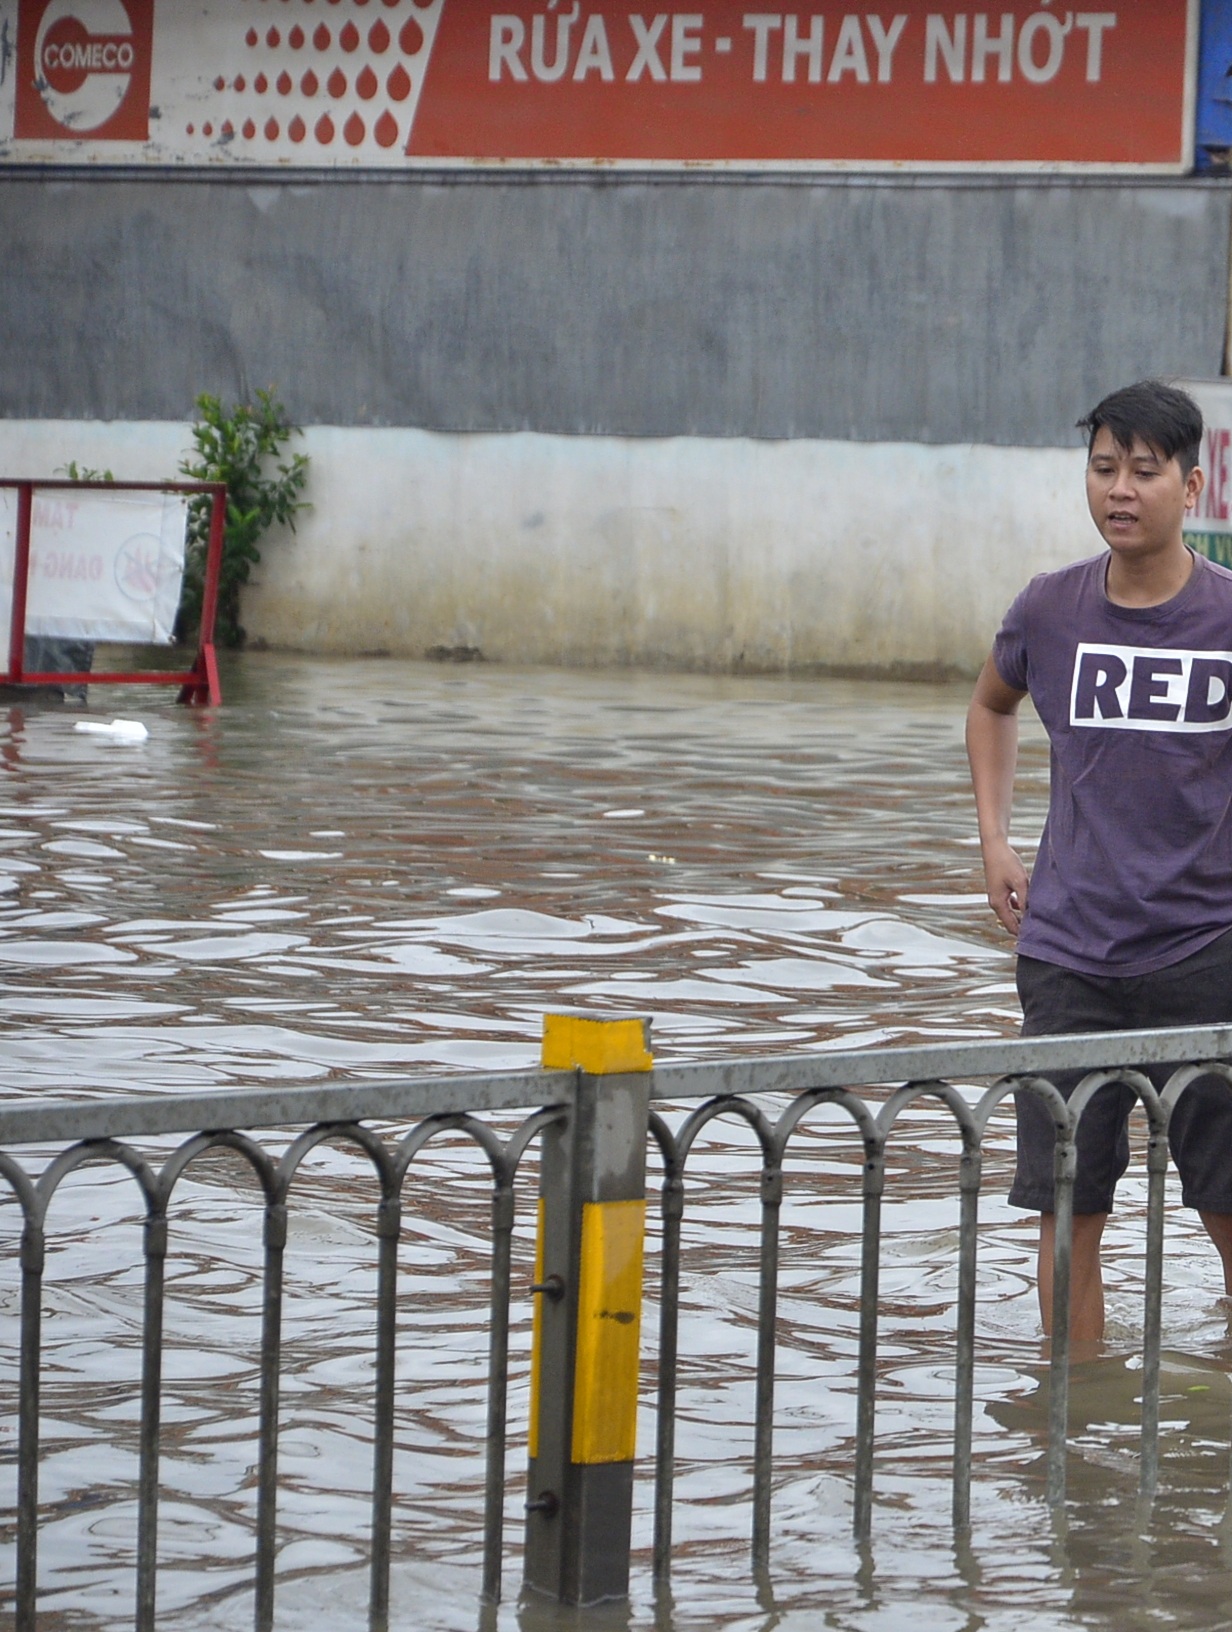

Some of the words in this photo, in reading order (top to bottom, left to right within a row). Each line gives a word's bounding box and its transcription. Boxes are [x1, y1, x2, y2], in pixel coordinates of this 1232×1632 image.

[44, 43, 133, 68] COMECO
[489, 0, 614, 82] RỬA
[625, 14, 703, 82] XE
[743, 13, 908, 83] THAY
[924, 0, 1116, 83] NHỚT
[1206, 427, 1231, 520] XE
[1186, 532, 1209, 557] CH
